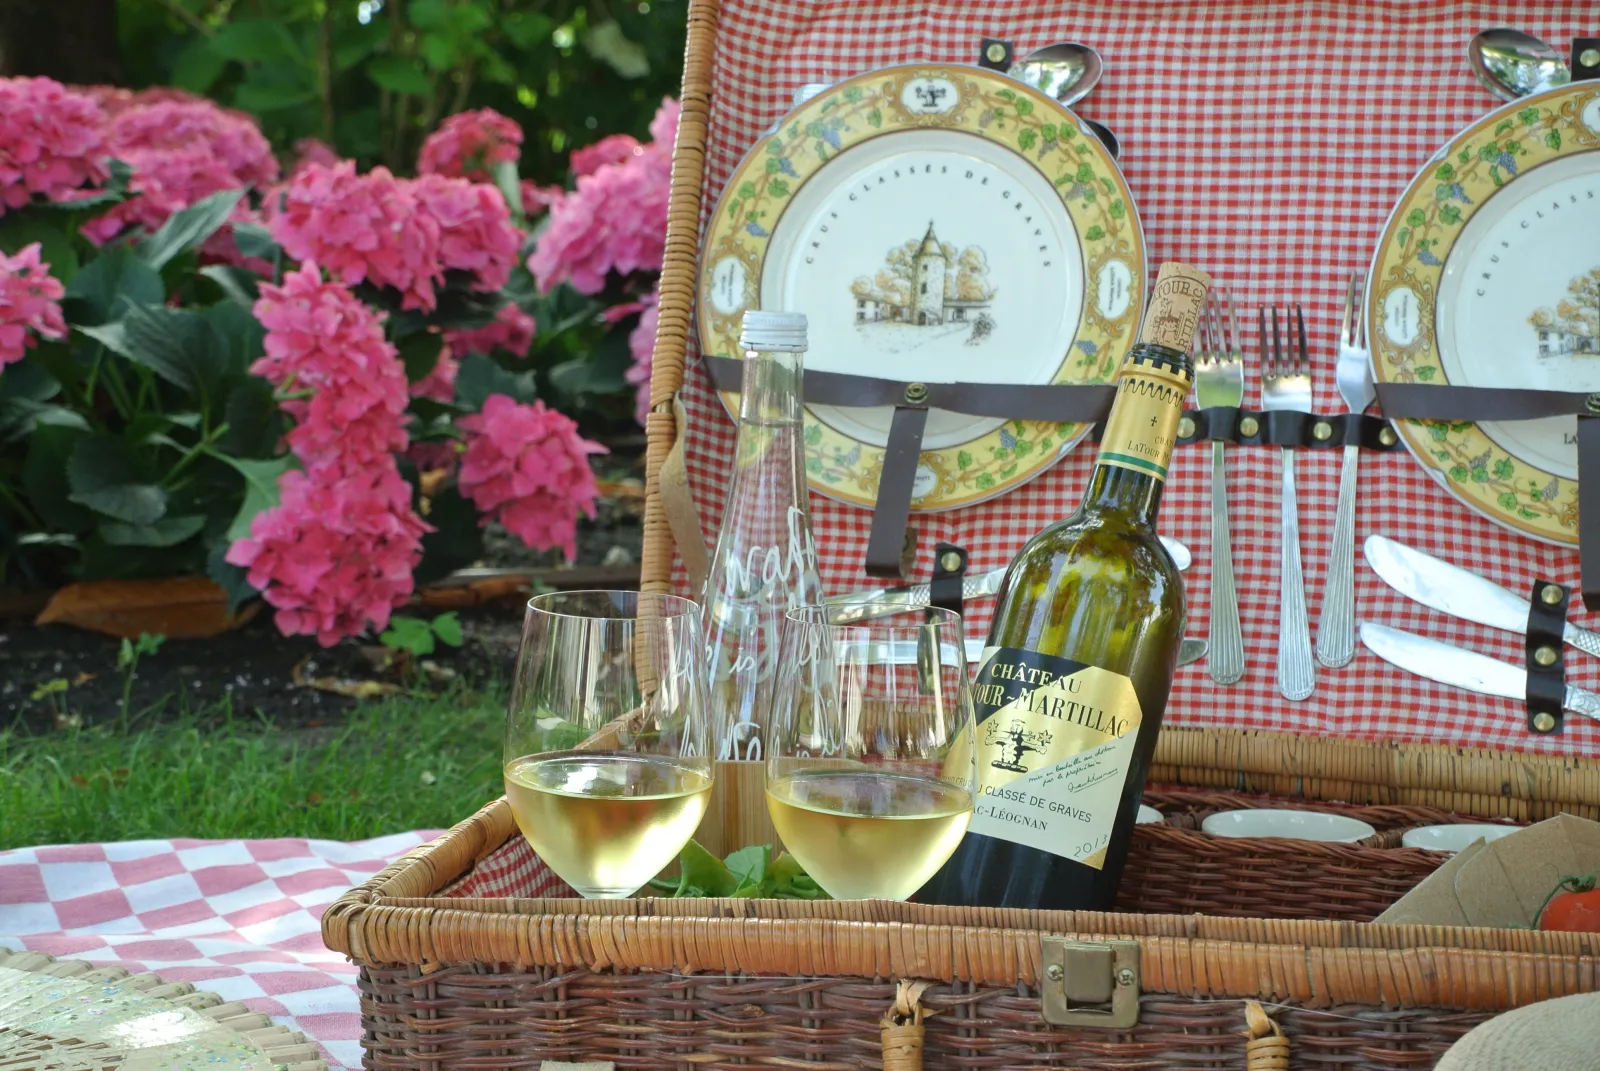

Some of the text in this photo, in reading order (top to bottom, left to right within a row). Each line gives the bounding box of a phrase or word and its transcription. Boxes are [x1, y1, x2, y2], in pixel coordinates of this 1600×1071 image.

[965, 170, 989, 185] DE
[1002, 190, 1051, 267] GRAVES
[1477, 241, 1509, 297] CRUS
[991, 662, 1083, 694] CHÂTEAU
[985, 785, 1092, 823] CLASSÉ DE GRAVES
